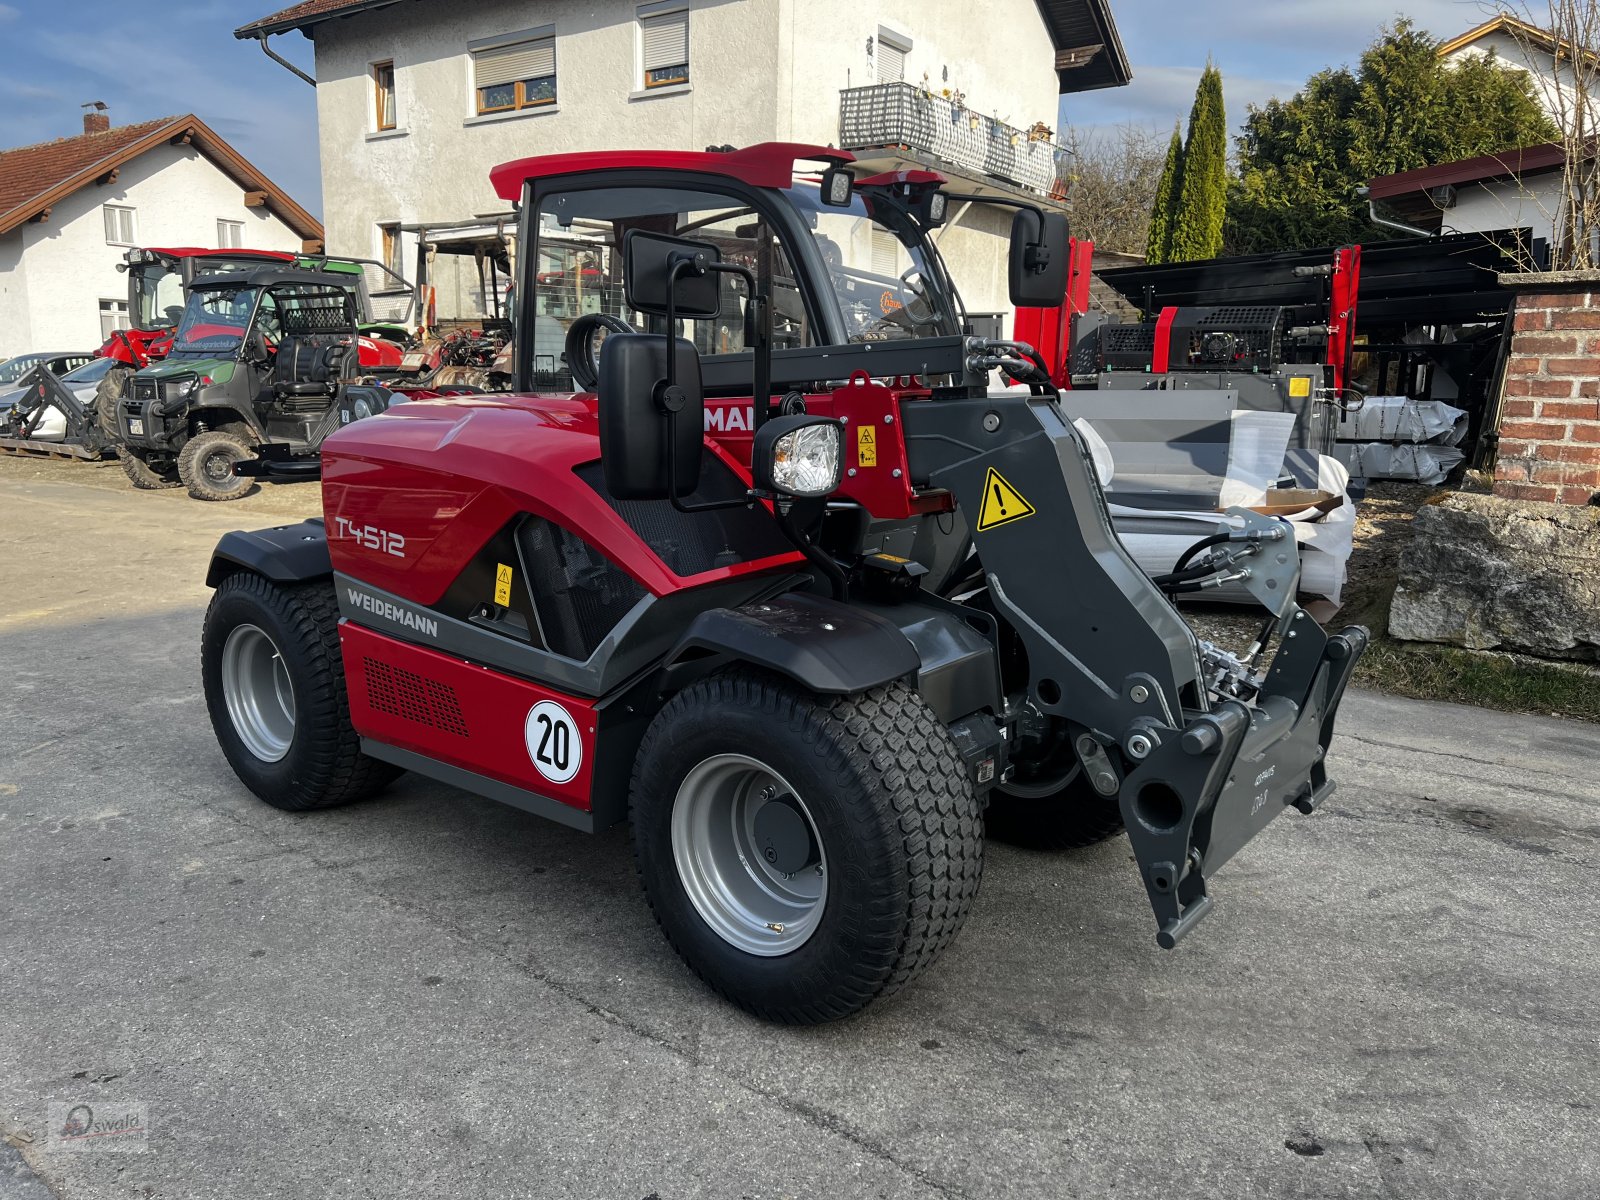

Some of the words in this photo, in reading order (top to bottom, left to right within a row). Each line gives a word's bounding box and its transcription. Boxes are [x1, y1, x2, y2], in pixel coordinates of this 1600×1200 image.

[335, 516, 406, 558] T4512
[347, 587, 438, 638] WEIDEMANN
[536, 713, 570, 771] 20
